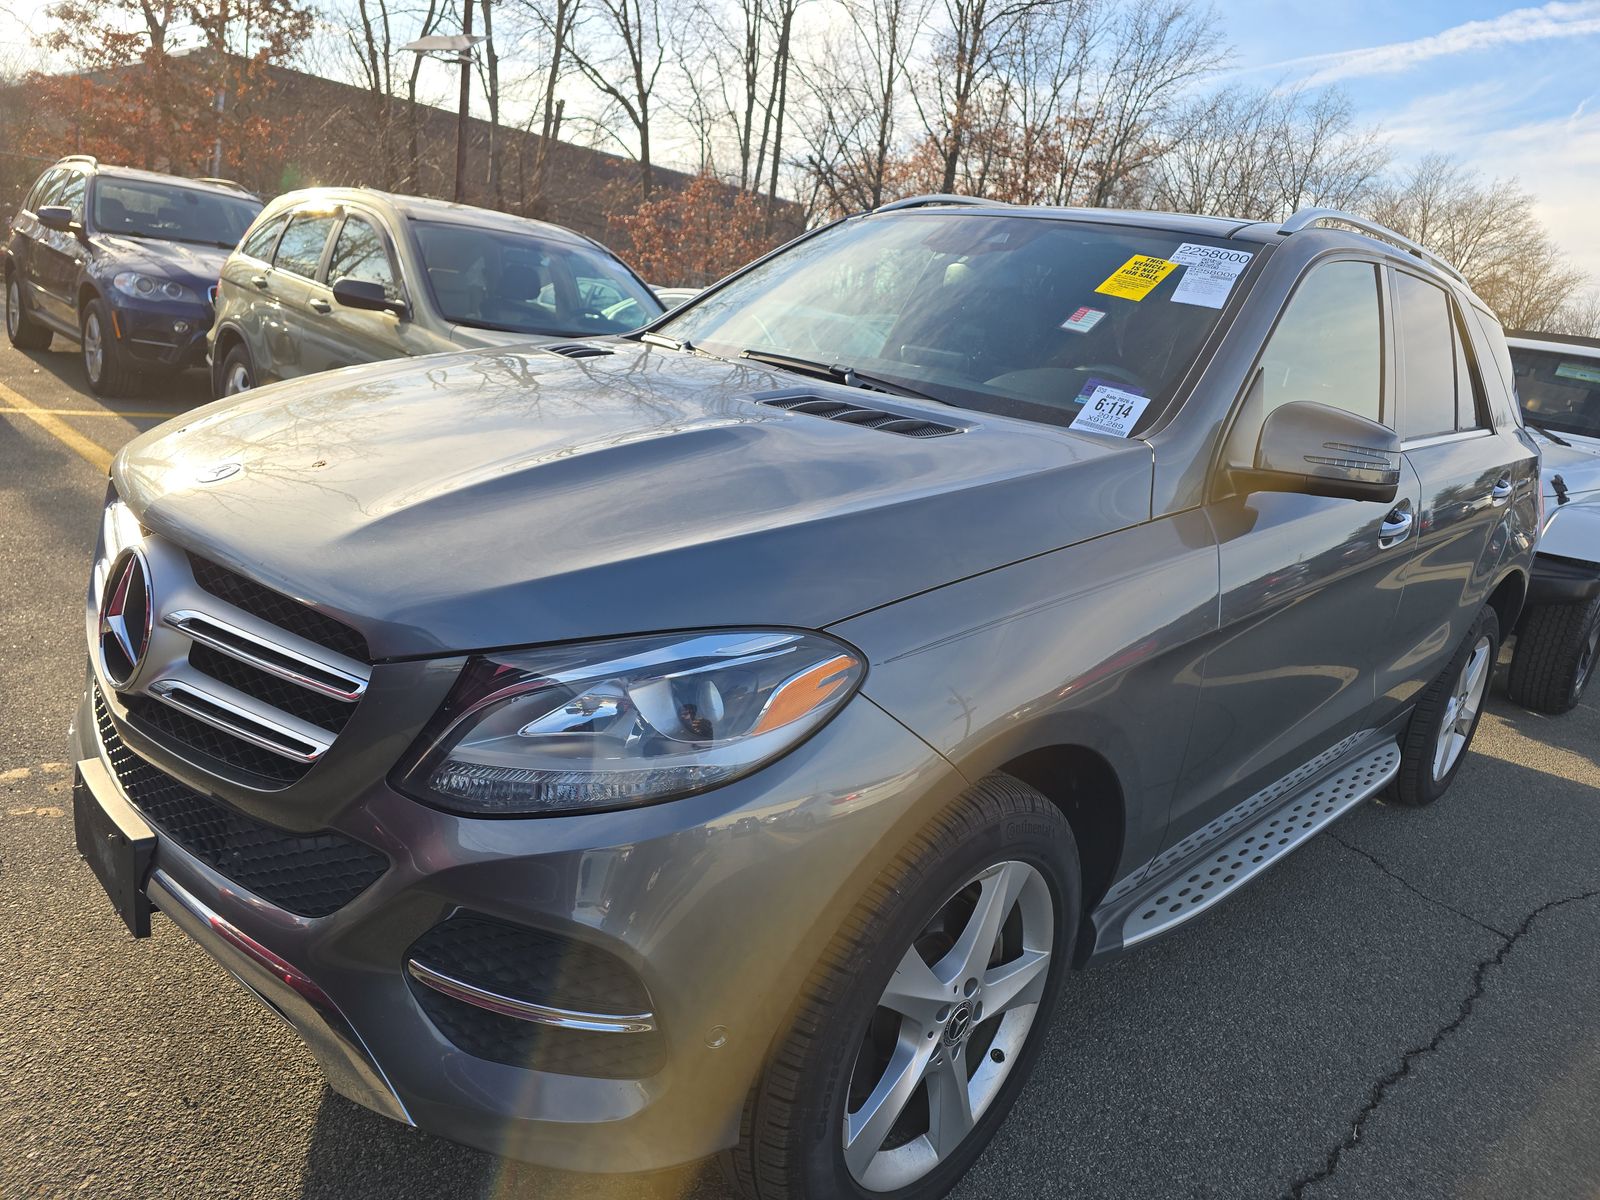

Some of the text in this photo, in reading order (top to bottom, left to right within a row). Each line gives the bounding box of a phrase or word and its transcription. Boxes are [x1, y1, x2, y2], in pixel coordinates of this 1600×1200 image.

[1179, 245, 1250, 264] 2258000
[1134, 260, 1167, 271] VEHICLE
[1145, 257, 1165, 265] THIS
[1142, 267, 1159, 275] NOT
[1105, 393, 1117, 401] Sale
[1094, 398, 1133, 418] 6:114
[1096, 411, 1121, 422] 2017
